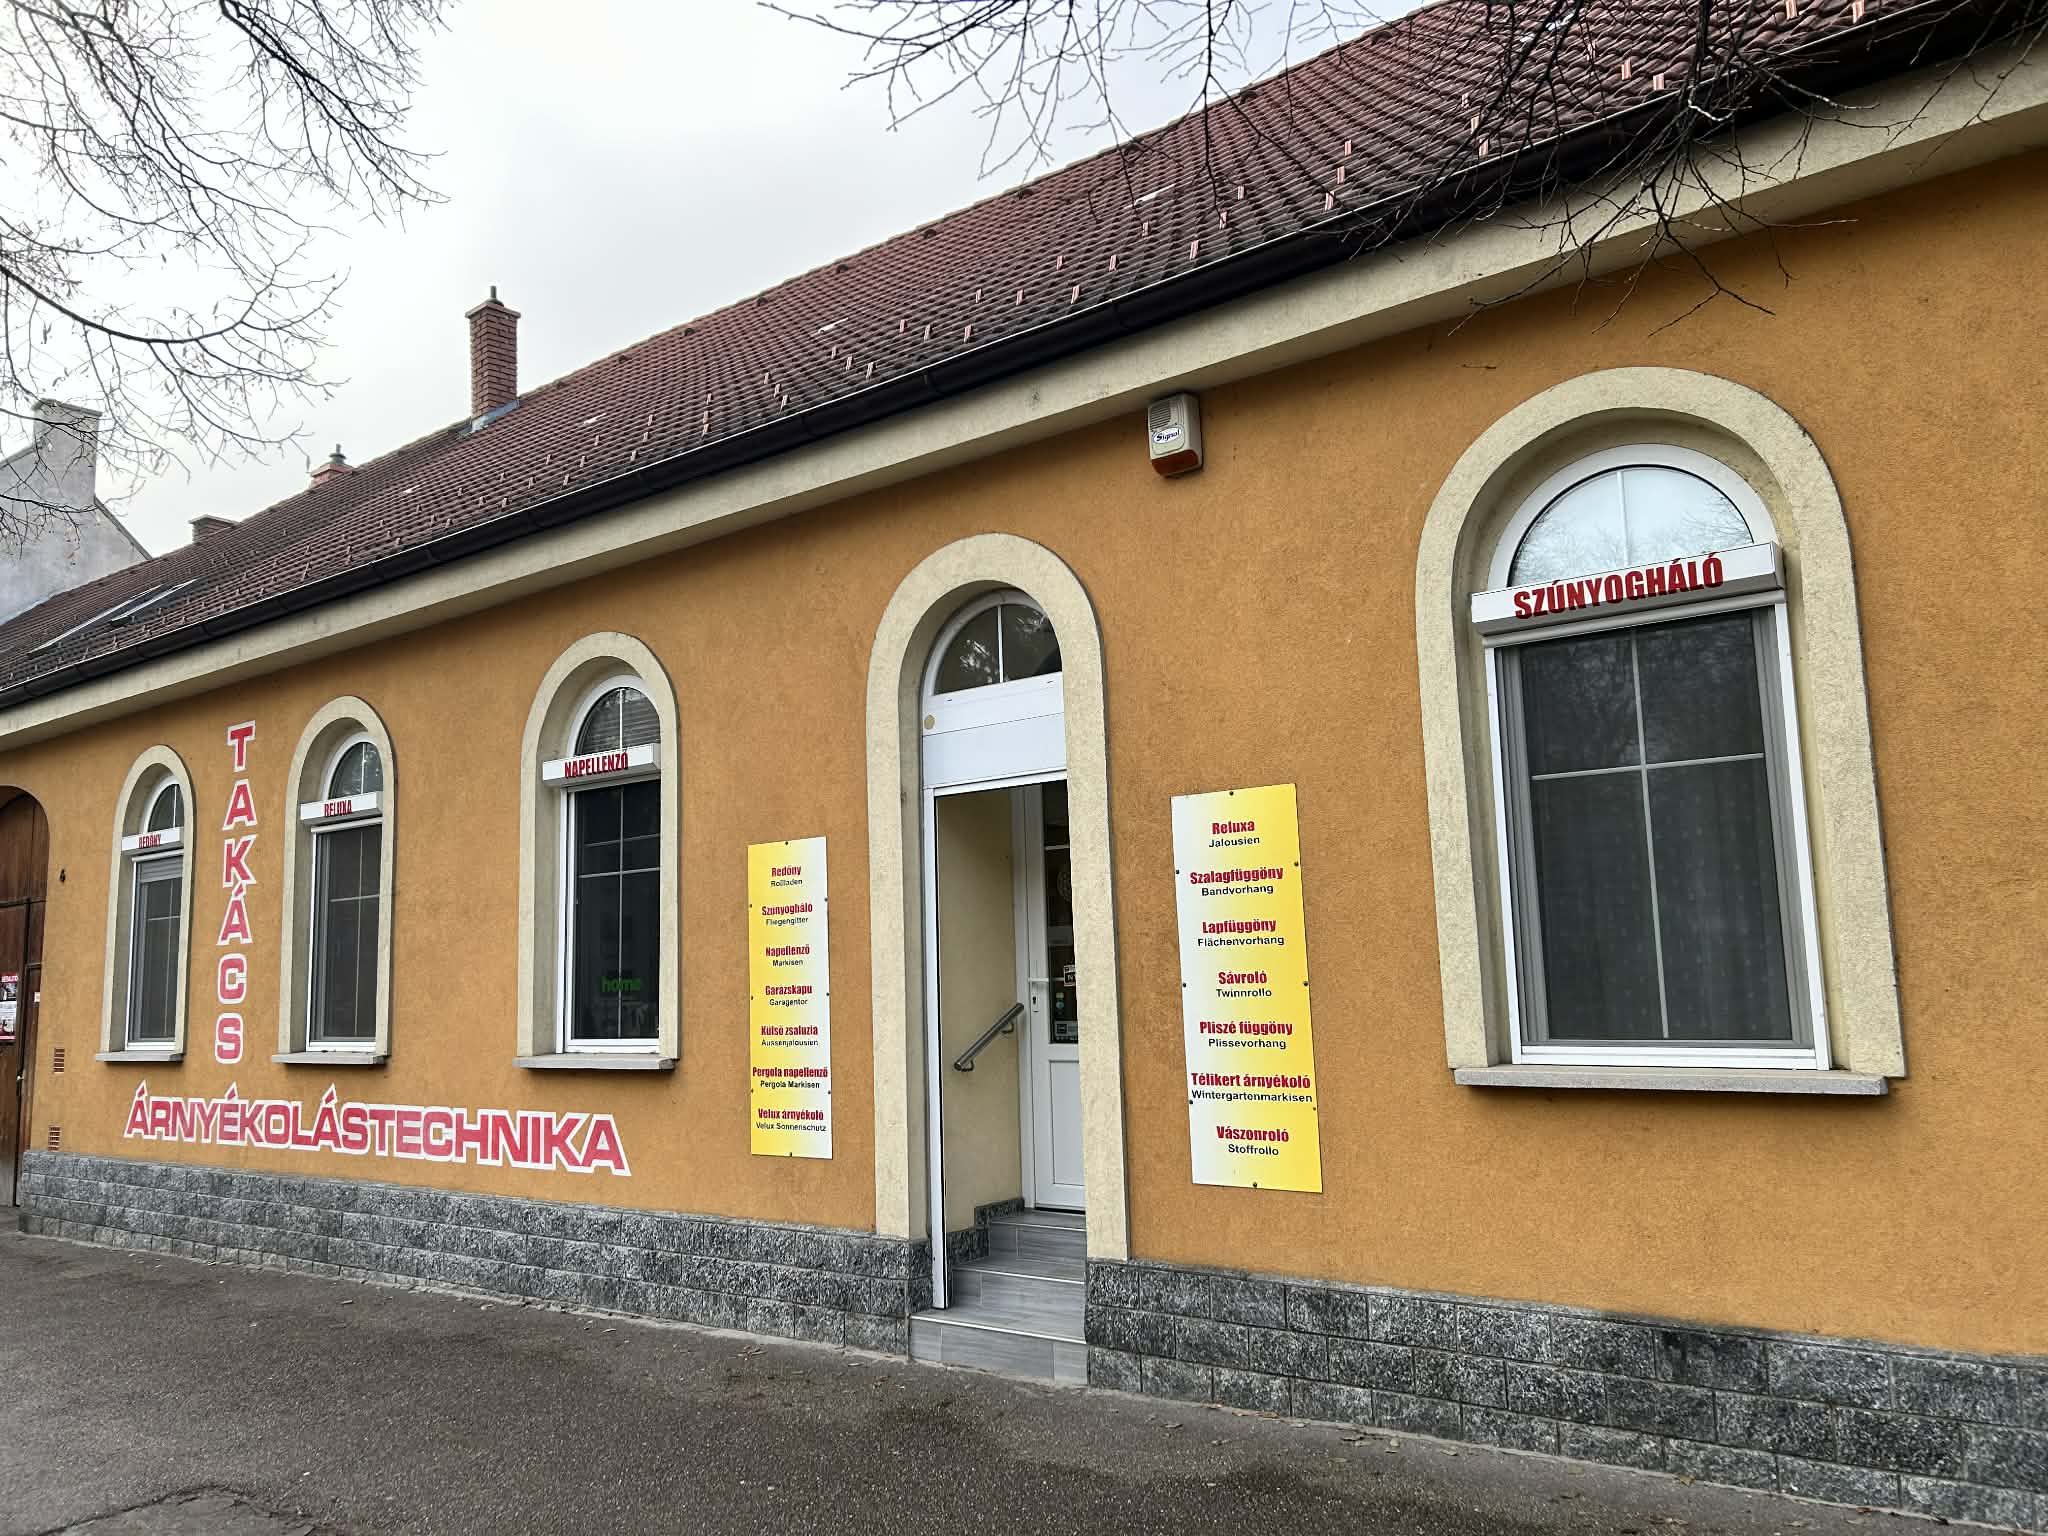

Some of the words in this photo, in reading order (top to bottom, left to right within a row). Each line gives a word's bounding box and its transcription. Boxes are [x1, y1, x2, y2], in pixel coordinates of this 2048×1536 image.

[1513, 551, 1724, 620] SZÚNYOGHÁLÓ
[324, 799, 353, 817] RELUXA
[1212, 820, 1256, 835] Reluxa
[1208, 837, 1260, 848] Jalousien
[1190, 867, 1284, 884] Szalagfüggöny
[213, 720, 257, 1064] TAKÁCS
[1201, 885, 1274, 896] Bandvorhang
[766, 917, 808, 926] Fliegengitter
[1202, 919, 1276, 934] Lapfüggöny
[1197, 936, 1285, 947] Flächenvorhang
[1218, 971, 1268, 985] Sávroló
[1216, 988, 1272, 998] Twinnrollo
[769, 998, 808, 1007] Garagentor
[1199, 1021, 1236, 1034] Pliszé
[1238, 1021, 1293, 1036] függöny
[761, 1039, 819, 1048] Aussenjalousien
[1208, 1038, 1287, 1050] Plissevorhang
[752, 1066, 783, 1078] Pergola
[760, 1080, 787, 1090] Pergola
[787, 1080, 820, 1089] Markisen
[1191, 1072, 1240, 1087] Télikert
[1243, 1073, 1311, 1089] árnyékoló
[1191, 1089, 1313, 1103] Wintergartenmarkisen
[757, 1108, 781, 1119] Velux
[123, 1079, 633, 1177] ÁRNYÉKOLÁSTECHNIKA
[756, 1122, 775, 1130] Velux
[776, 1122, 827, 1132] Sonnenschutz
[1216, 1125, 1289, 1142] Vászonroló
[1228, 1143, 1279, 1156] Stoffrollo
